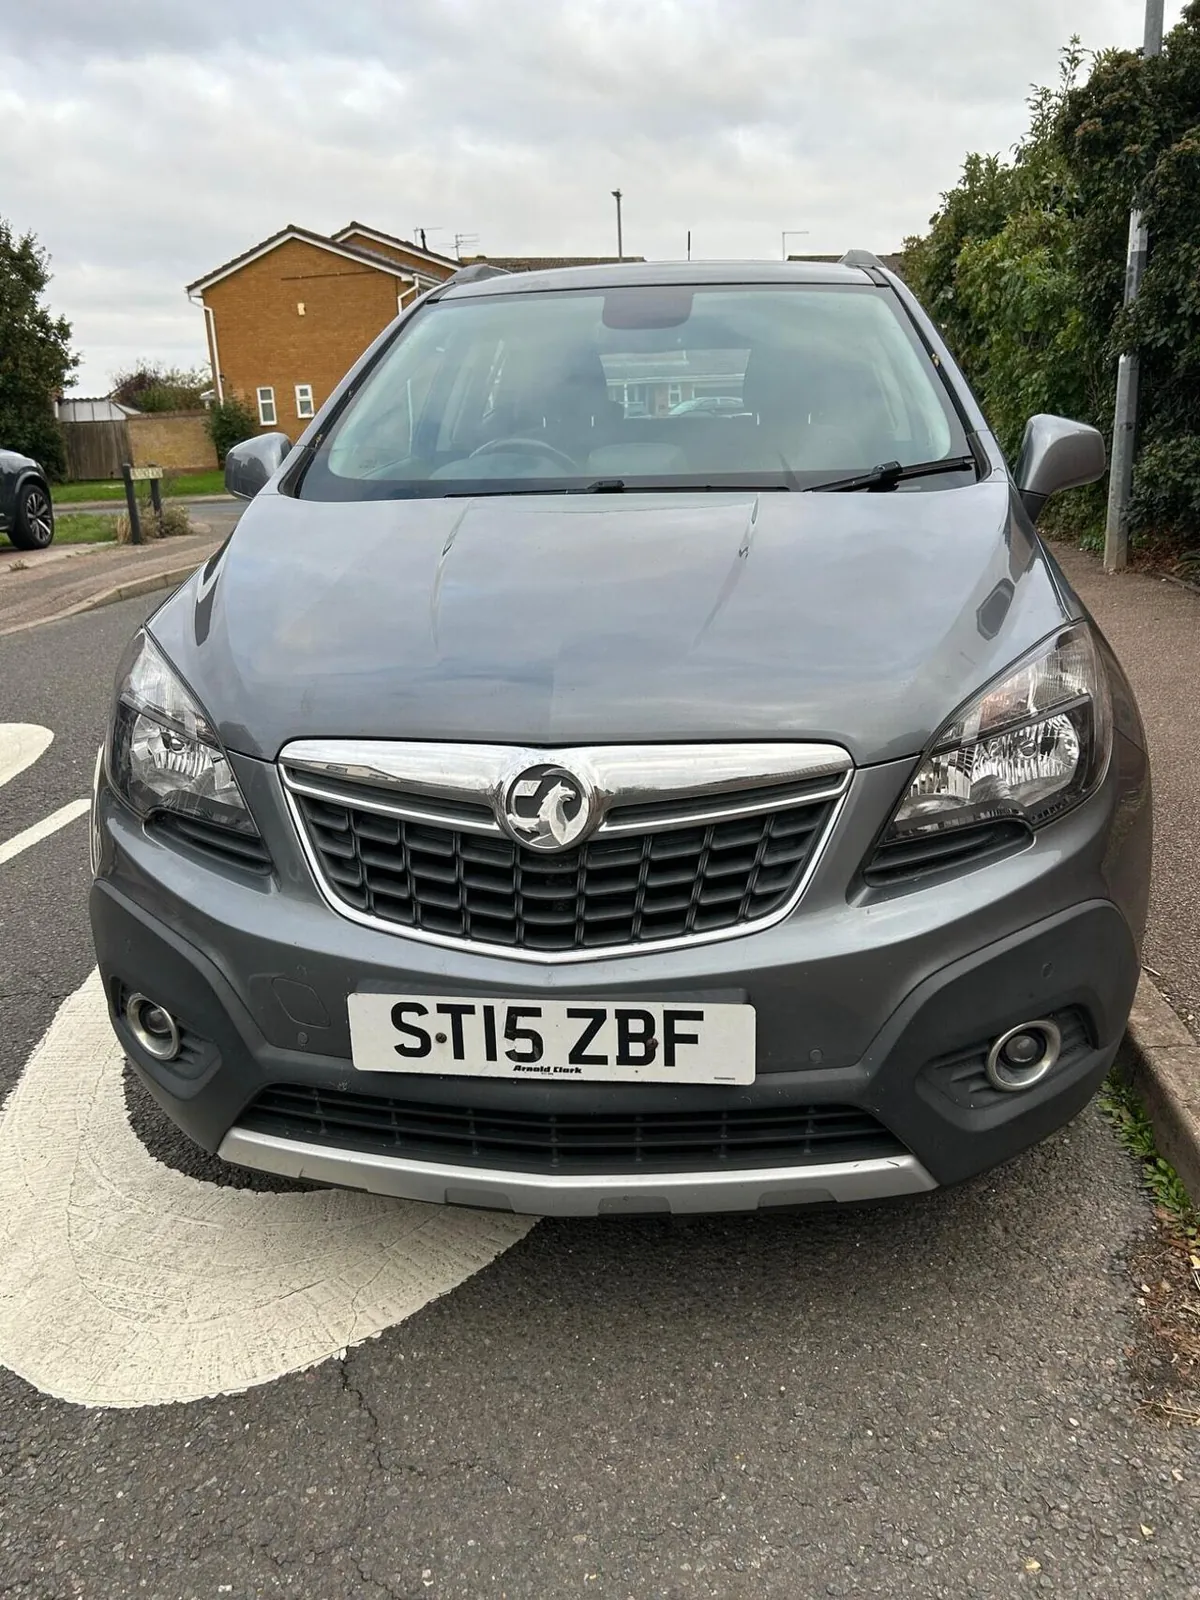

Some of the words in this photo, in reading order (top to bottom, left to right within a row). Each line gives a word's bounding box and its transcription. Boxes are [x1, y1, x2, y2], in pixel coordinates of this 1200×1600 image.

[391, 1001, 544, 1063] ST15
[566, 1007, 705, 1067] ZBF
[513, 1065, 551, 1073] Arnold
